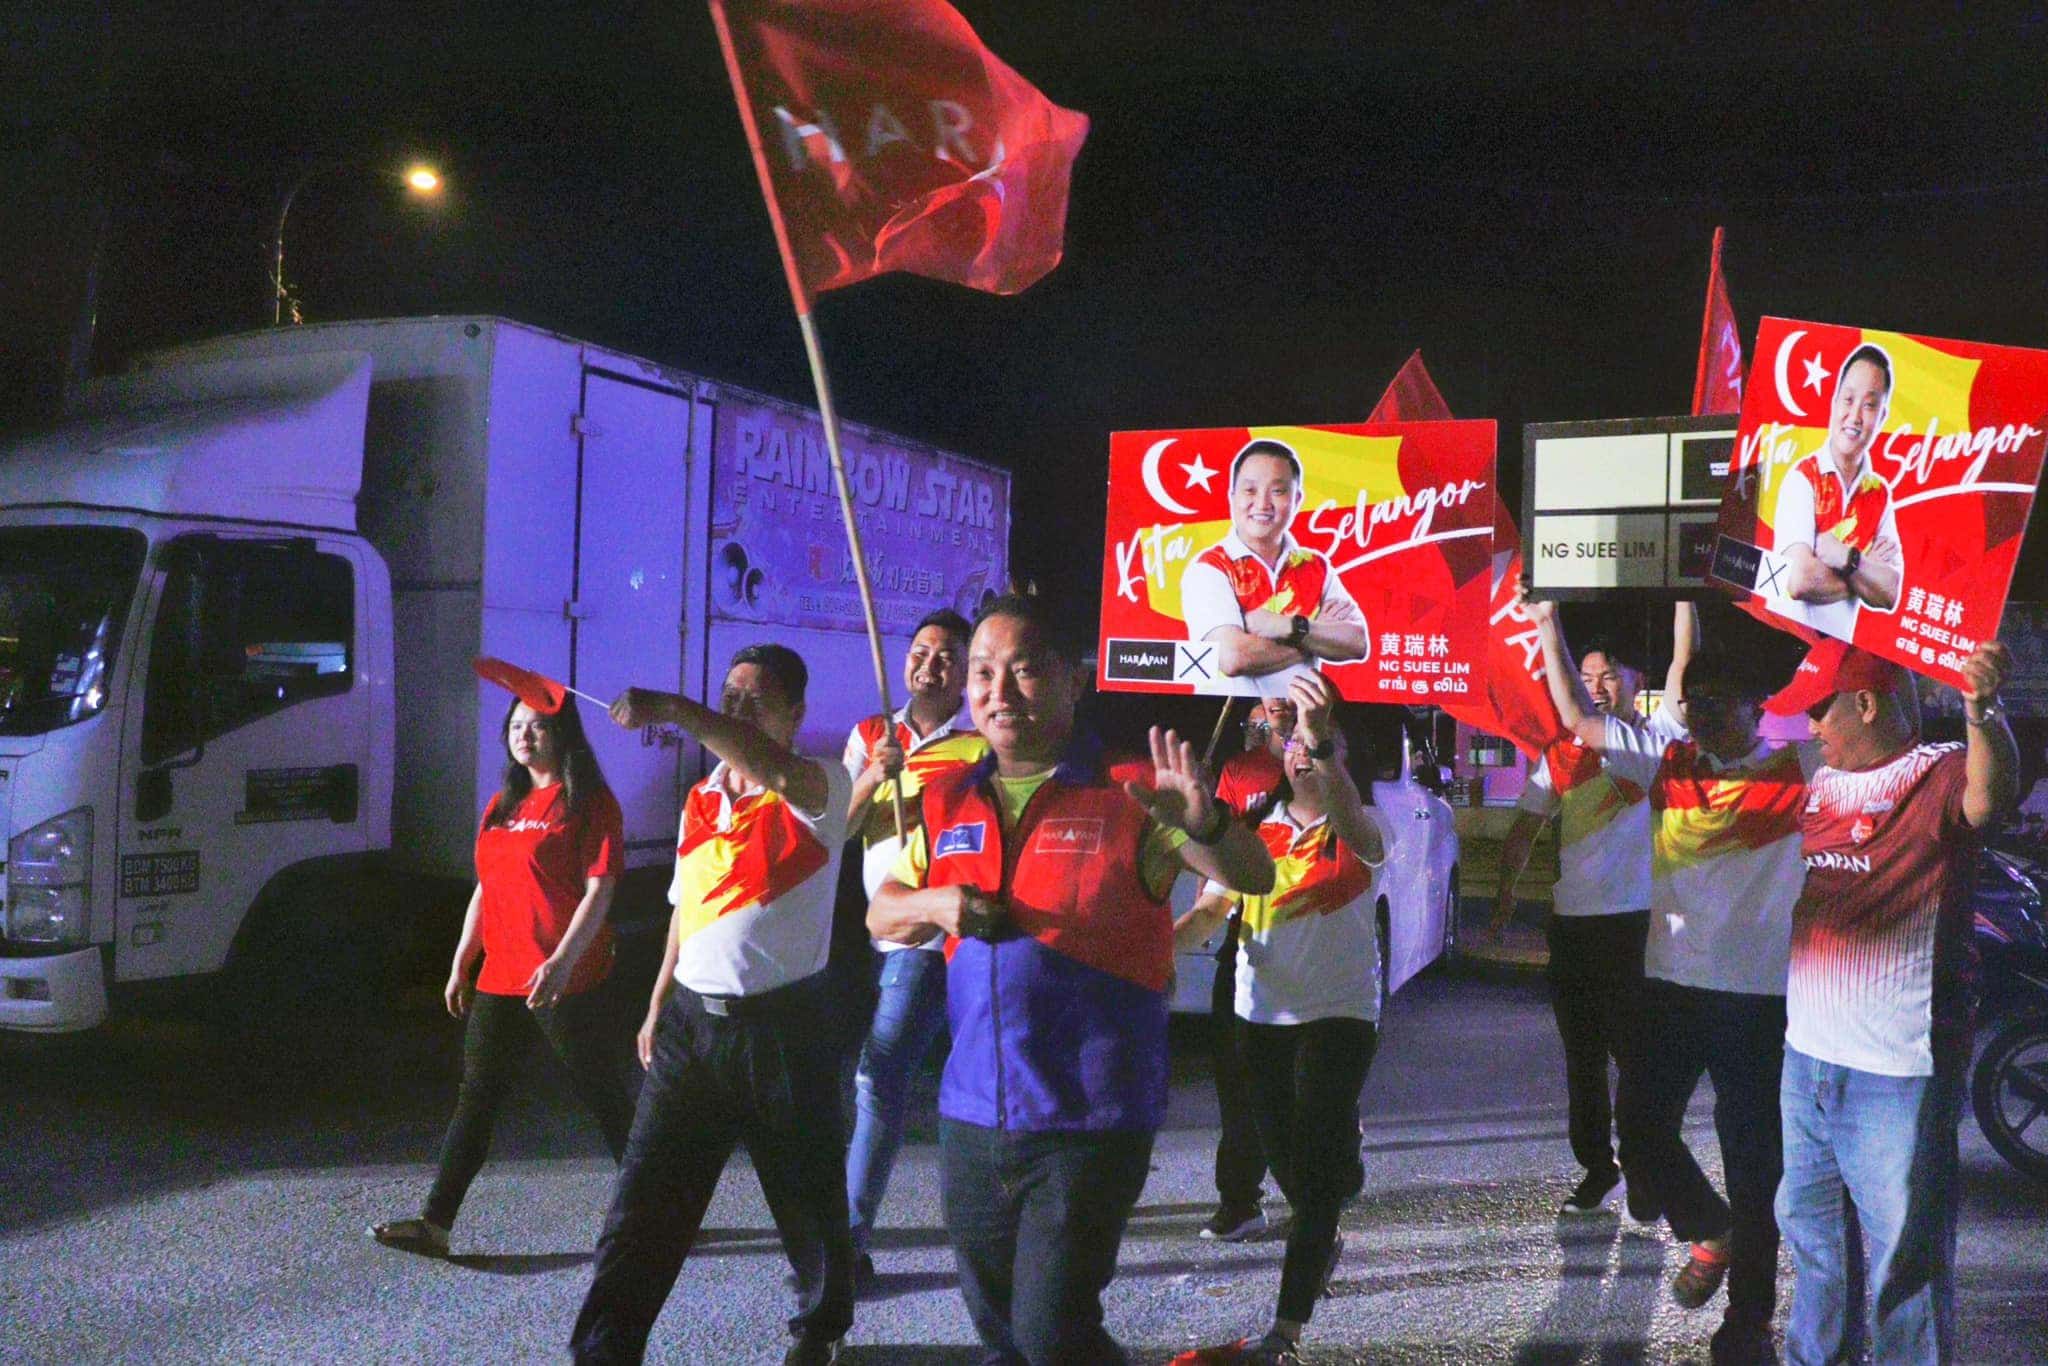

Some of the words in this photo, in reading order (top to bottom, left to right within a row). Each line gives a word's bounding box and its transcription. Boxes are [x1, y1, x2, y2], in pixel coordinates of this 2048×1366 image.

[1882, 416, 2043, 490] Selangor
[734, 414, 912, 513] RAINBOW
[917, 463, 995, 532] STAR
[1308, 477, 1487, 560] Selangor
[1115, 522, 1193, 604] Kita
[1541, 543, 1569, 559] NG
[1576, 542, 1617, 559] SUEE
[1623, 542, 1655, 558] LIM
[1906, 586, 1964, 628] 黄瑞林
[1380, 632, 1449, 658] 黄瑞林
[1900, 616, 1918, 632] NG
[1919, 622, 1951, 645] SUEE
[1951, 634, 1976, 653] LIM
[1119, 652, 1168, 667] HARAPAN
[1379, 660, 1400, 672] NG
[1403, 661, 1441, 673] SUEE
[1444, 662, 1470, 675] LIM
